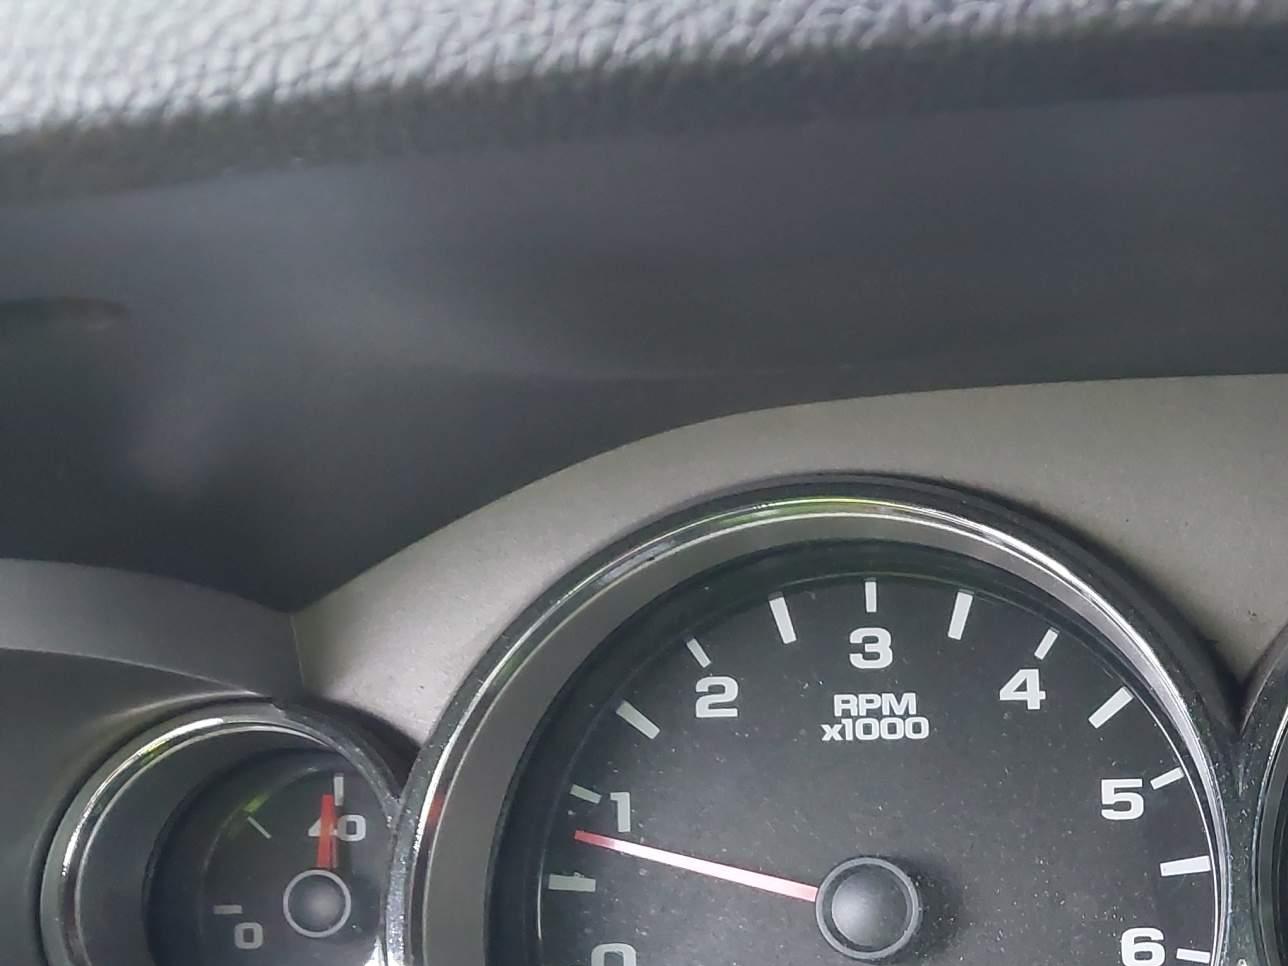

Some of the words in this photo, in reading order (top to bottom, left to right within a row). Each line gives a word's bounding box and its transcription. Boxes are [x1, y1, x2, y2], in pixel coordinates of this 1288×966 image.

[849, 627, 894, 670] 3
[695, 676, 739, 719] 2
[833, 692, 917, 718] RPM
[1000, 668, 1046, 712] 4
[821, 717, 930, 742] x1000
[610, 791, 631, 833] 1
[1101, 778, 1145, 821] 5
[234, 921, 264, 950] 0
